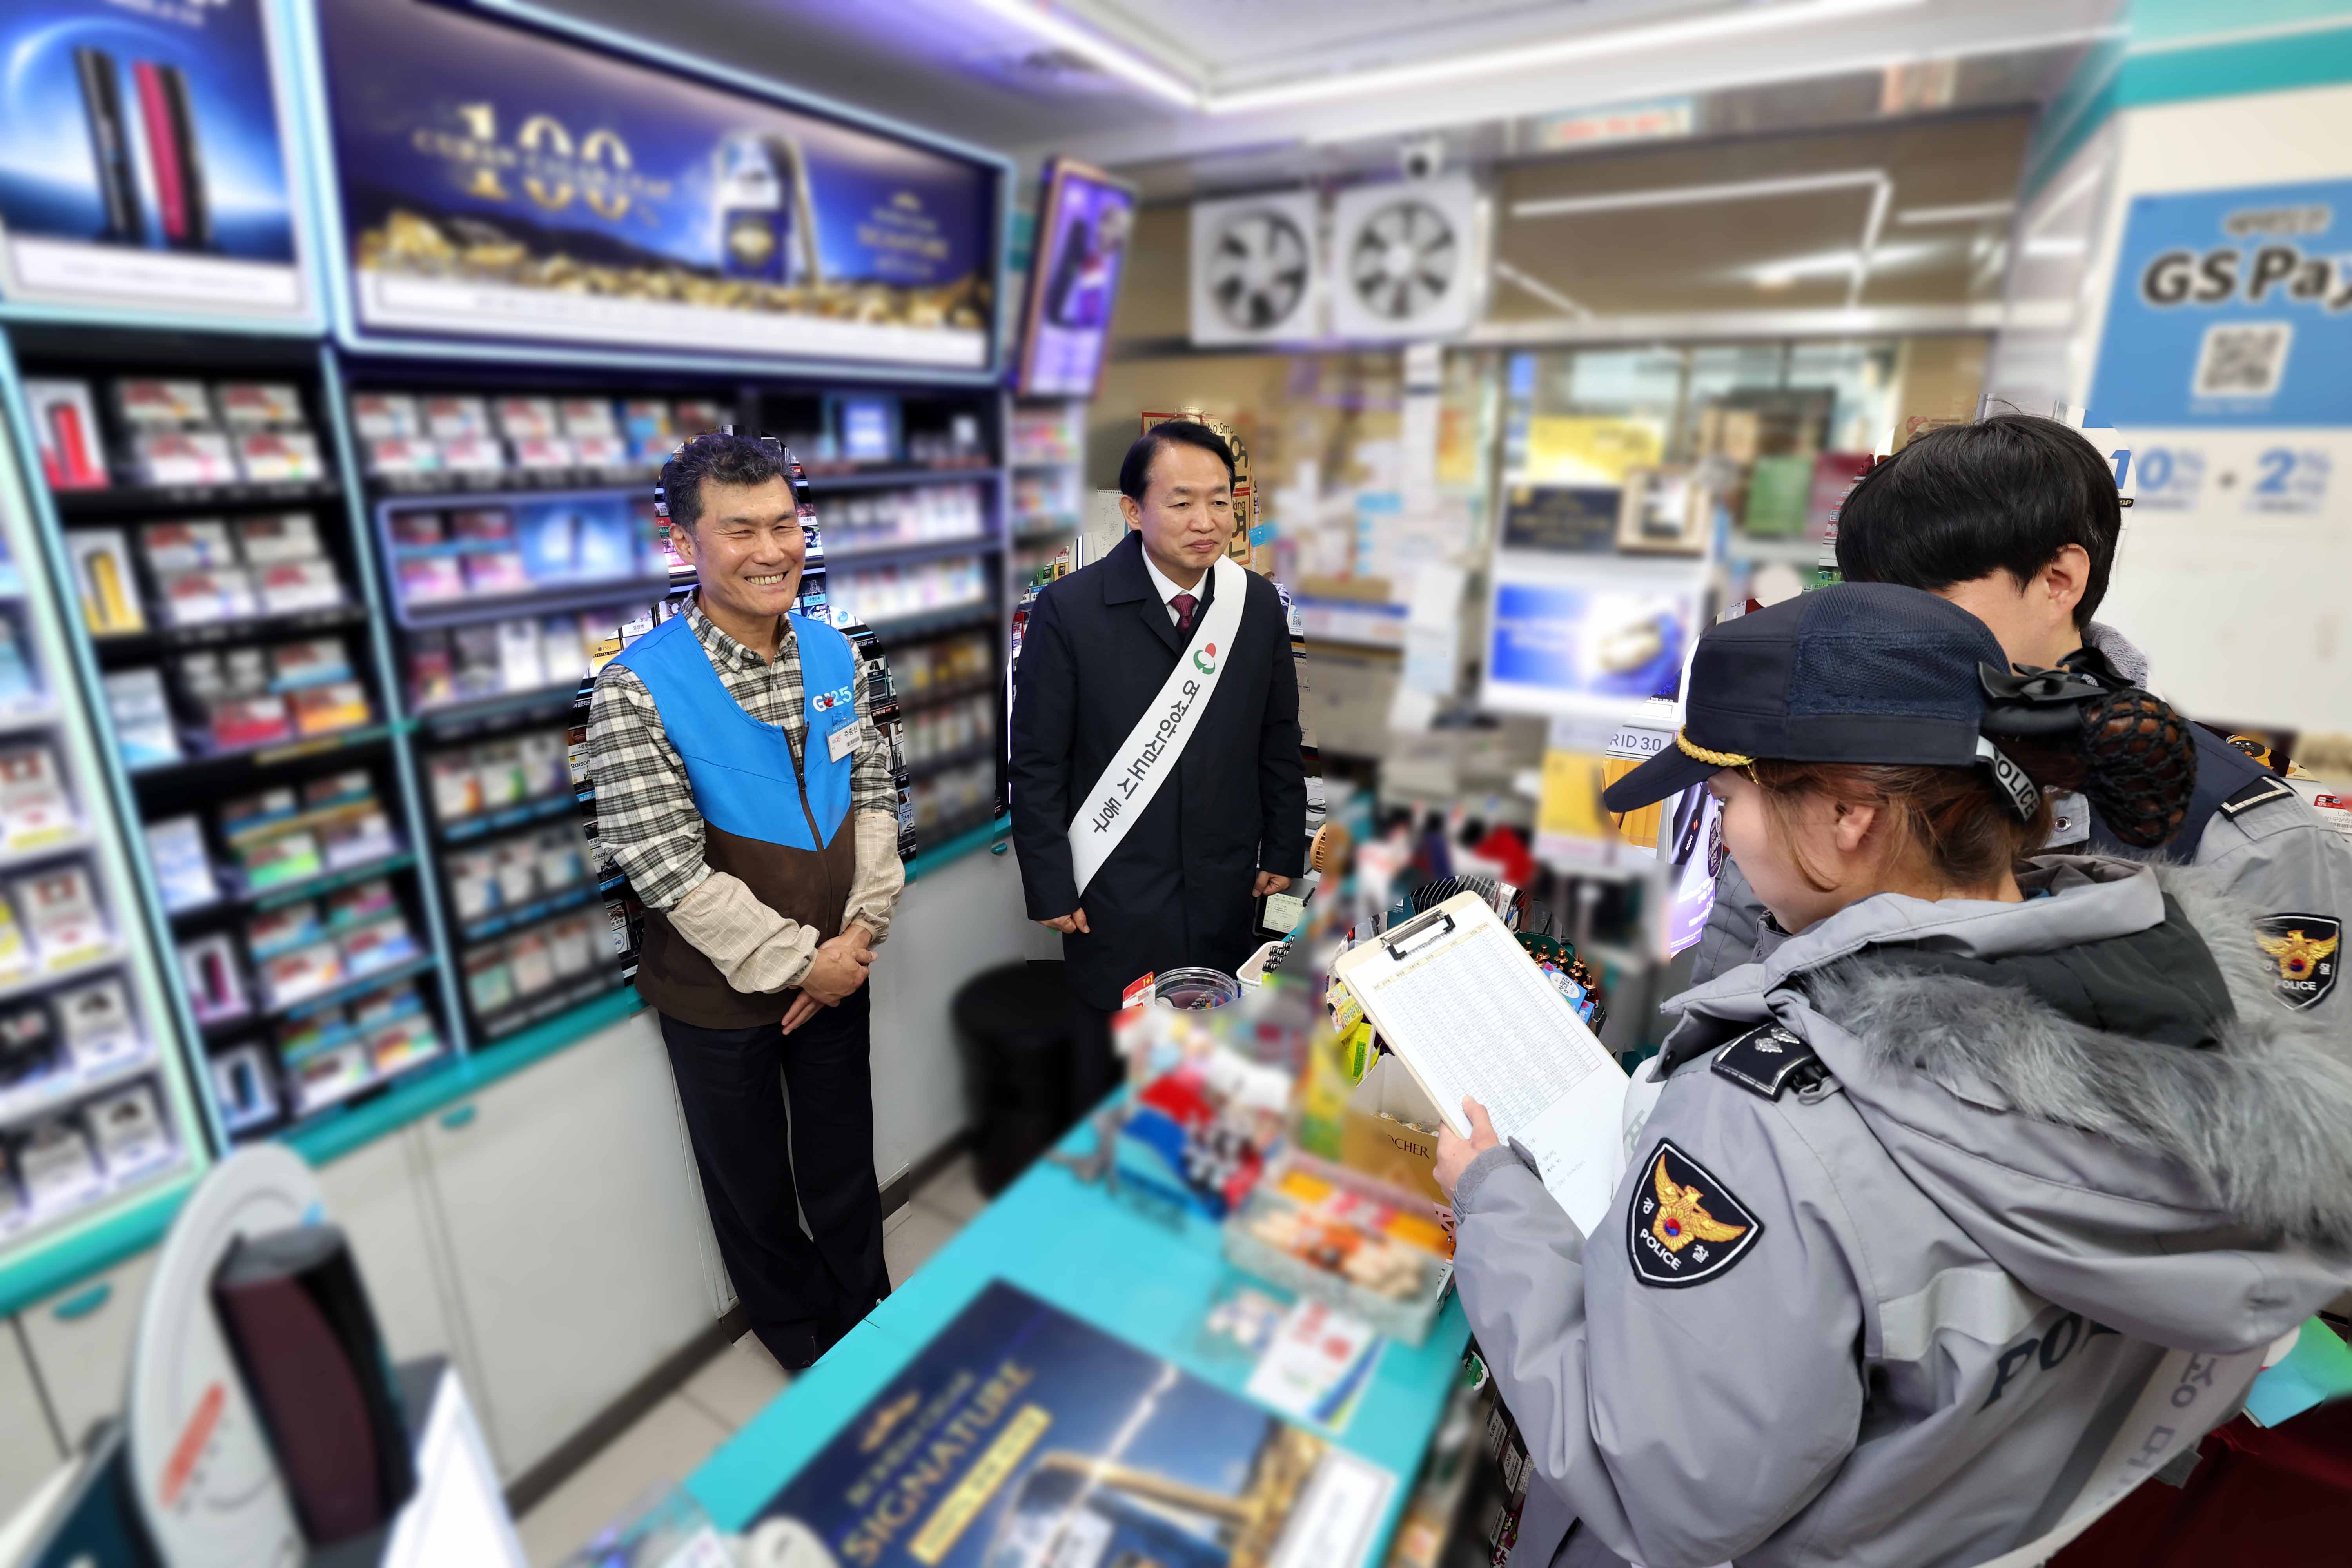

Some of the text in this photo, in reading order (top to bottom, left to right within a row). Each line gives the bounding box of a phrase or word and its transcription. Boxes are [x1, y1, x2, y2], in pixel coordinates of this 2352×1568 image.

[2143, 247, 2238, 307] GS
[1640, 737, 1662, 751] 3.0
[570, 760, 590, 768] Raison
[1092, 679, 1200, 834] 여성안심도시 동구
[1685, 834, 1694, 851] BOOST
[1142, 975, 1153, 987] 1+1
[1388, 1134, 1430, 1159] CHER
[1639, 1228, 1682, 1271] POLICE
